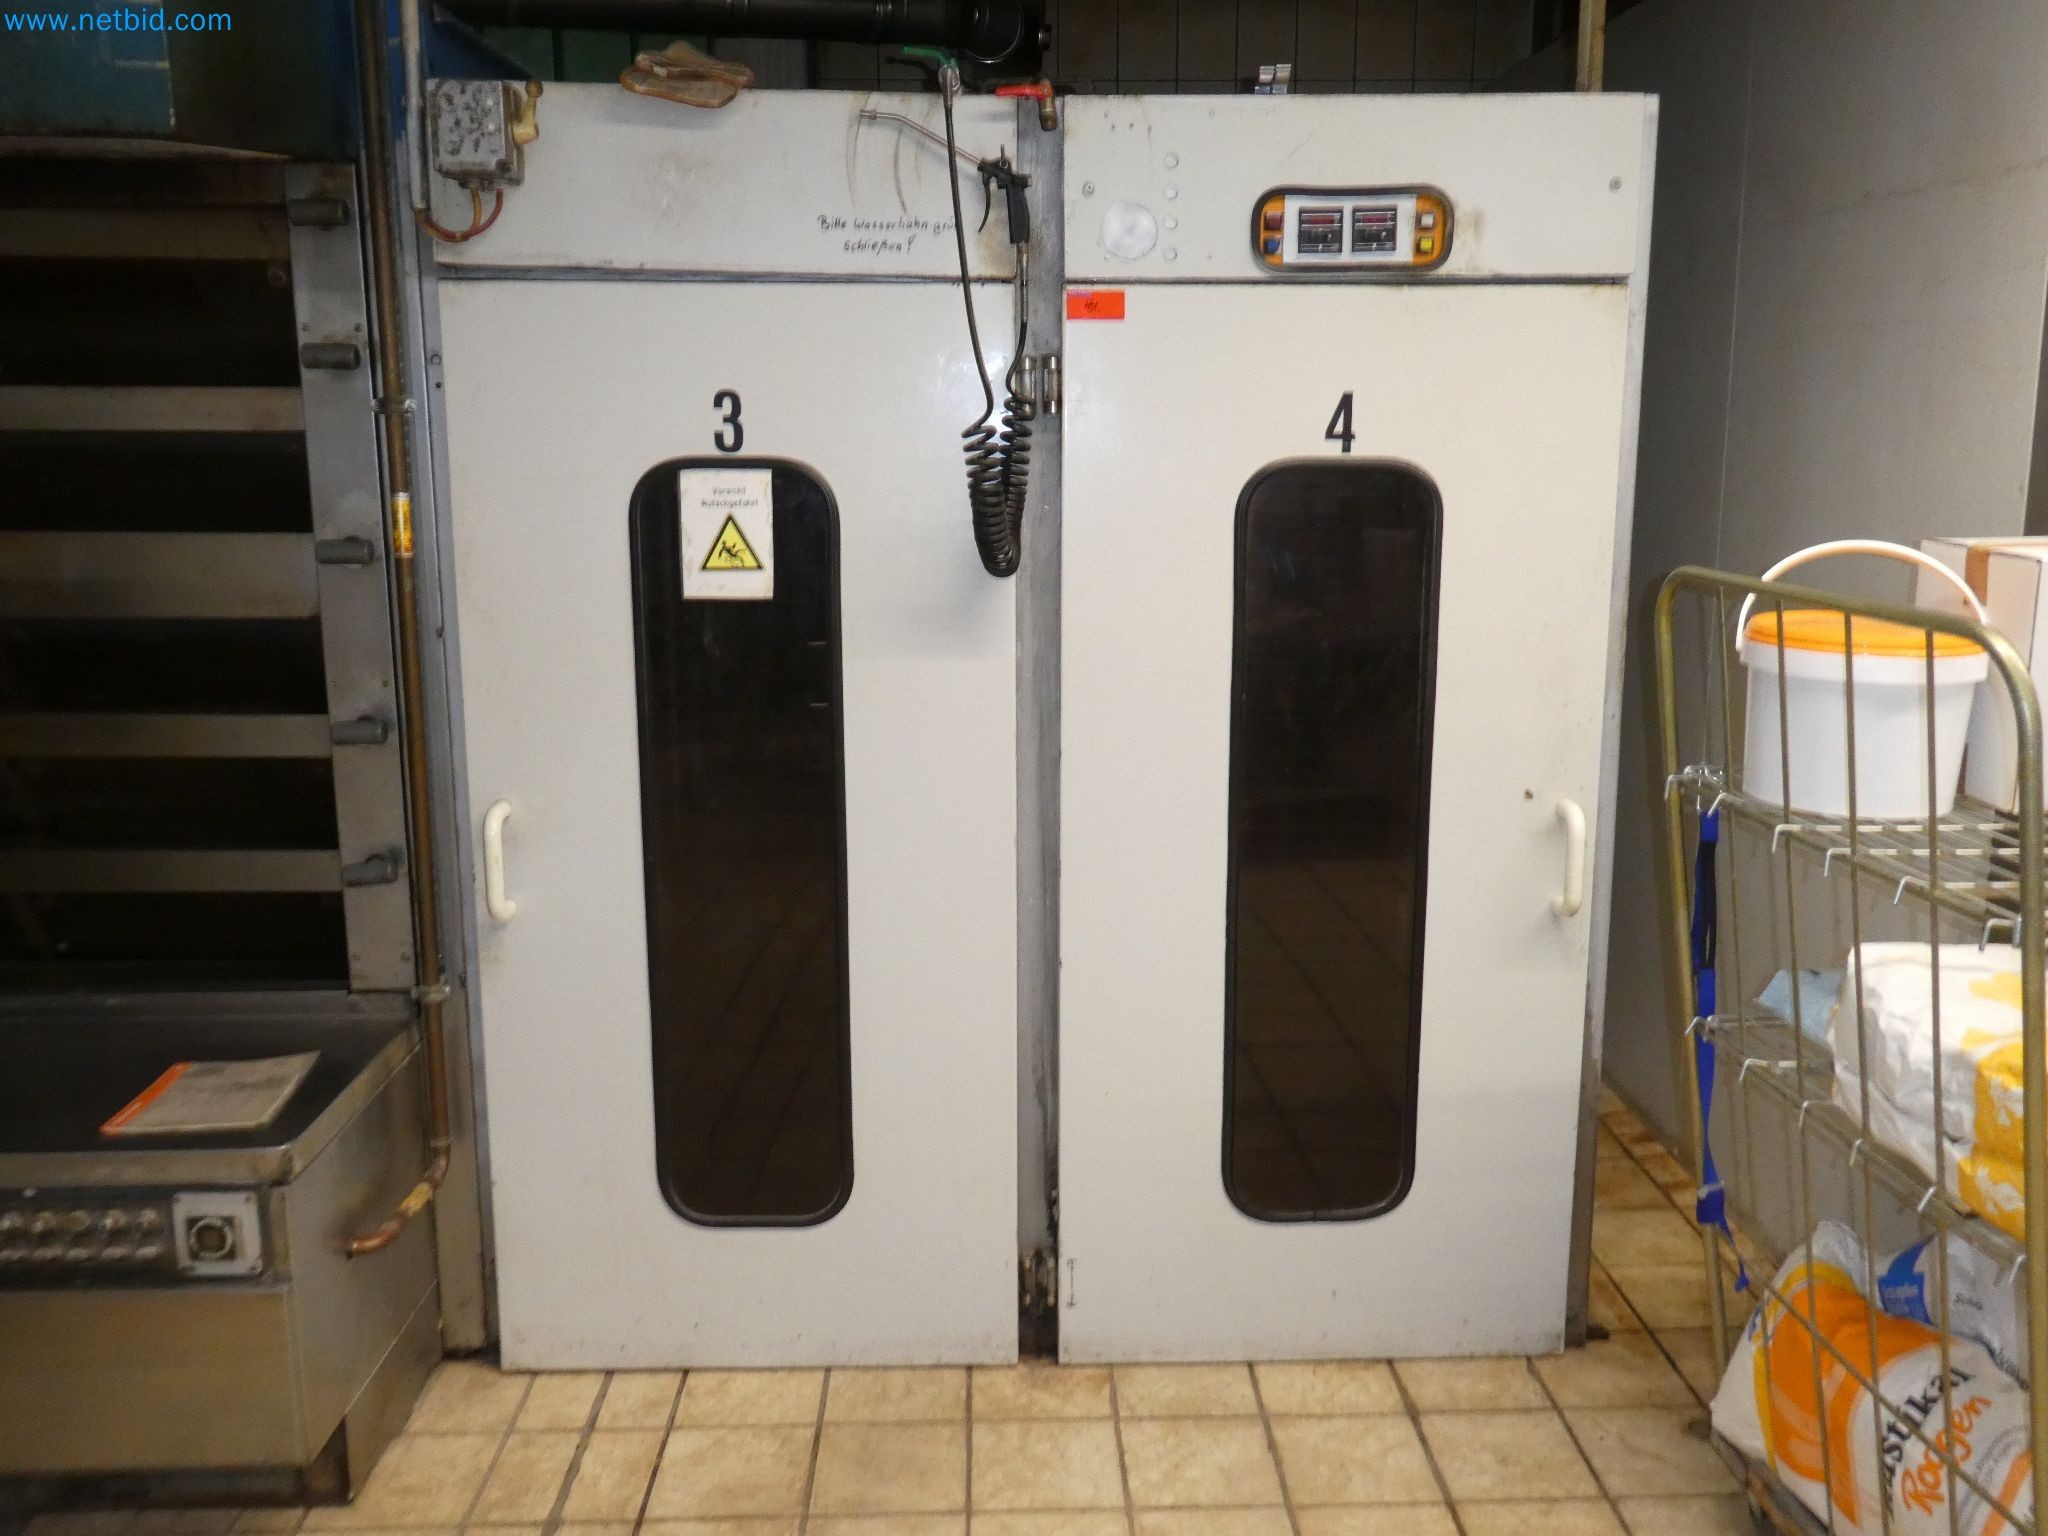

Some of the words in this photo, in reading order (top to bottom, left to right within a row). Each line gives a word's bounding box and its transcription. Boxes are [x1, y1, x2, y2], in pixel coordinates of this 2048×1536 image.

[817, 214, 847, 230] Bitte
[933, 215, 957, 235] grü
[713, 389, 744, 453] 3
[1324, 391, 1356, 453] 4
